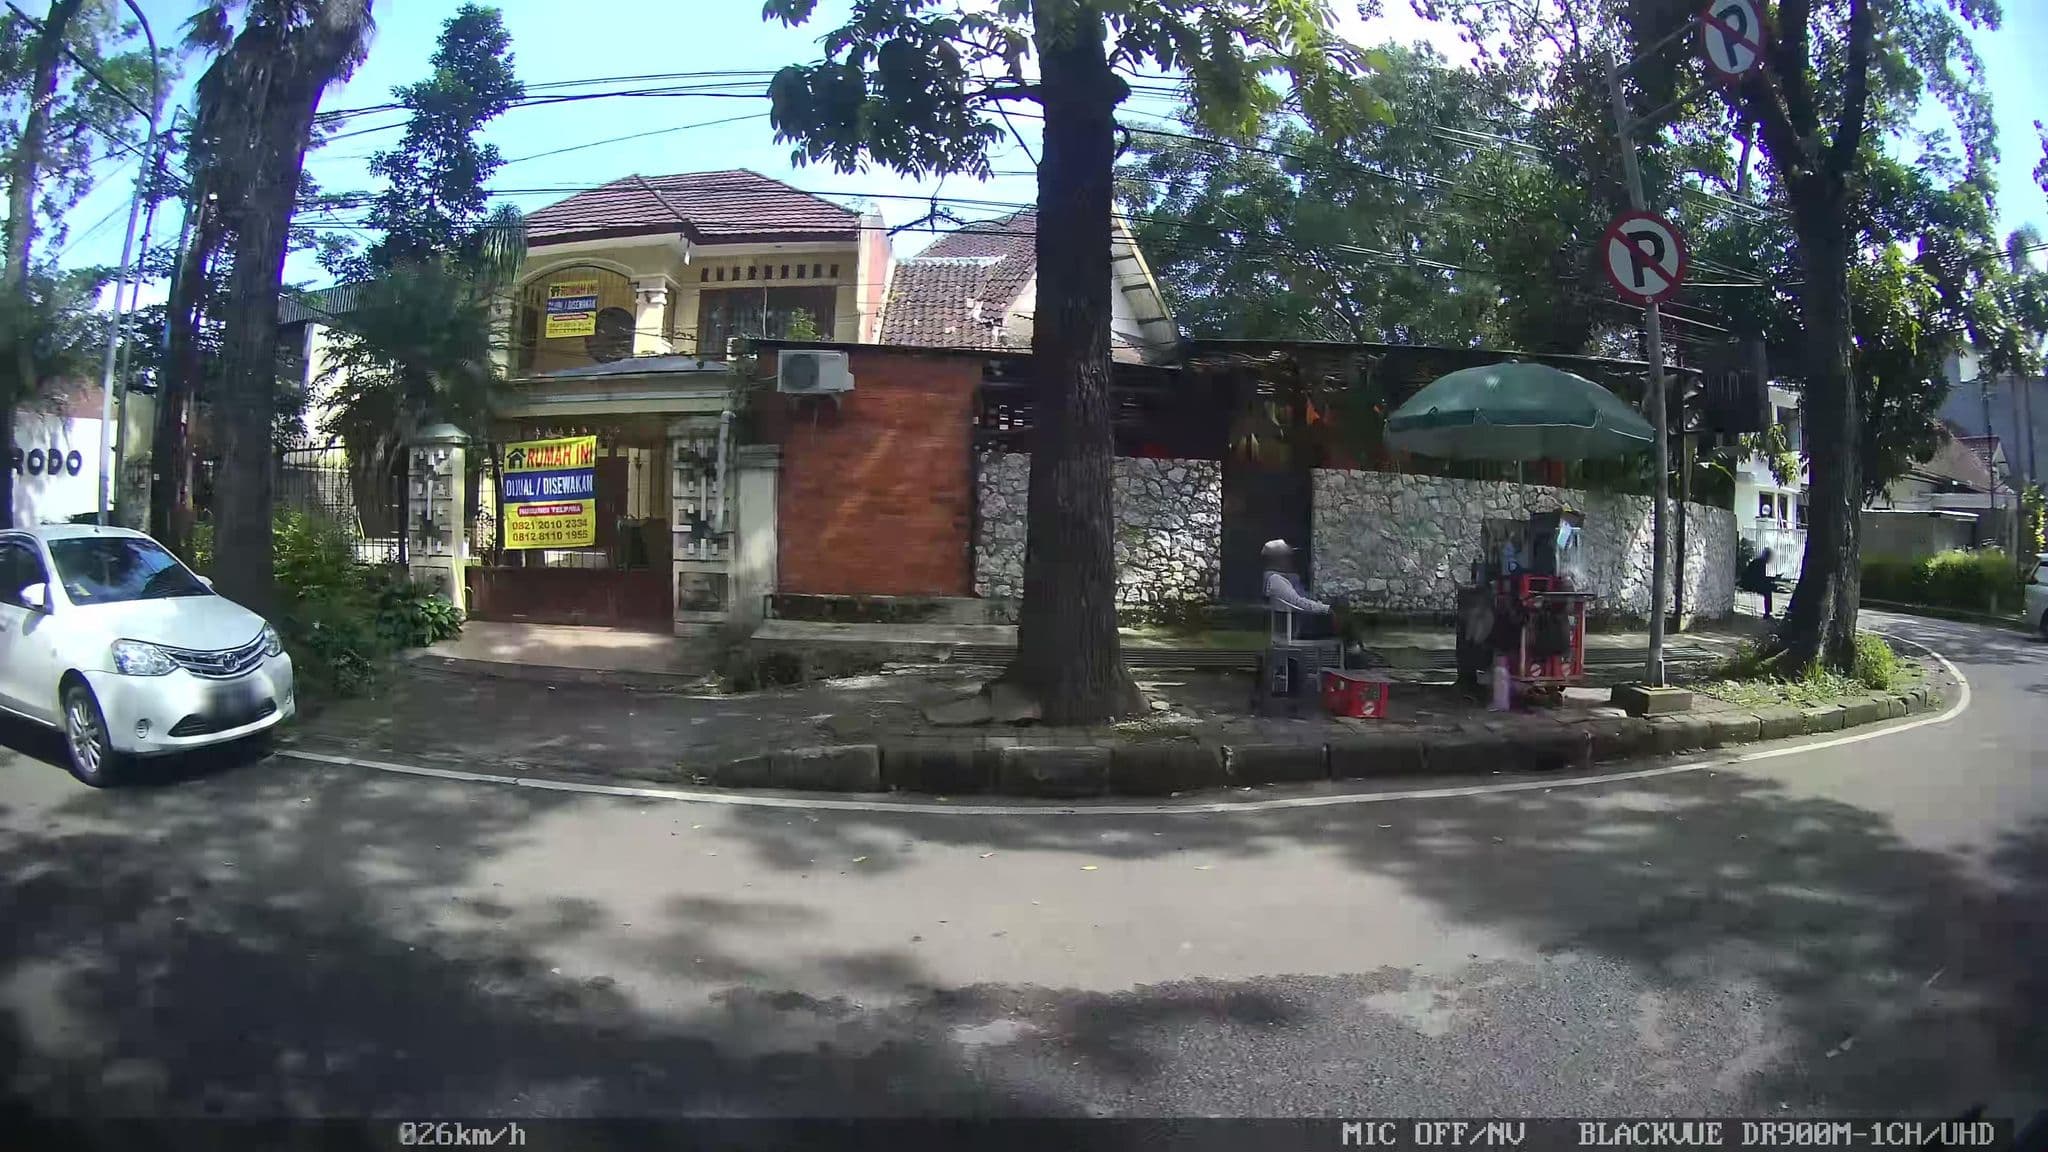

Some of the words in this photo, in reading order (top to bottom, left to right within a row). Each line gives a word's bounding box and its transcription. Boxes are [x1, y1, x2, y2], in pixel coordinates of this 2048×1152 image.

[527, 444, 571, 468] RUMAH
[506, 478, 534, 497] DIJUAL
[543, 475, 593, 494] DISEWAKAN
[512, 521, 535, 530] 0821
[538, 520, 562, 529] 2010
[512, 532, 536, 541] 0812
[538, 531, 562, 540] 8110
